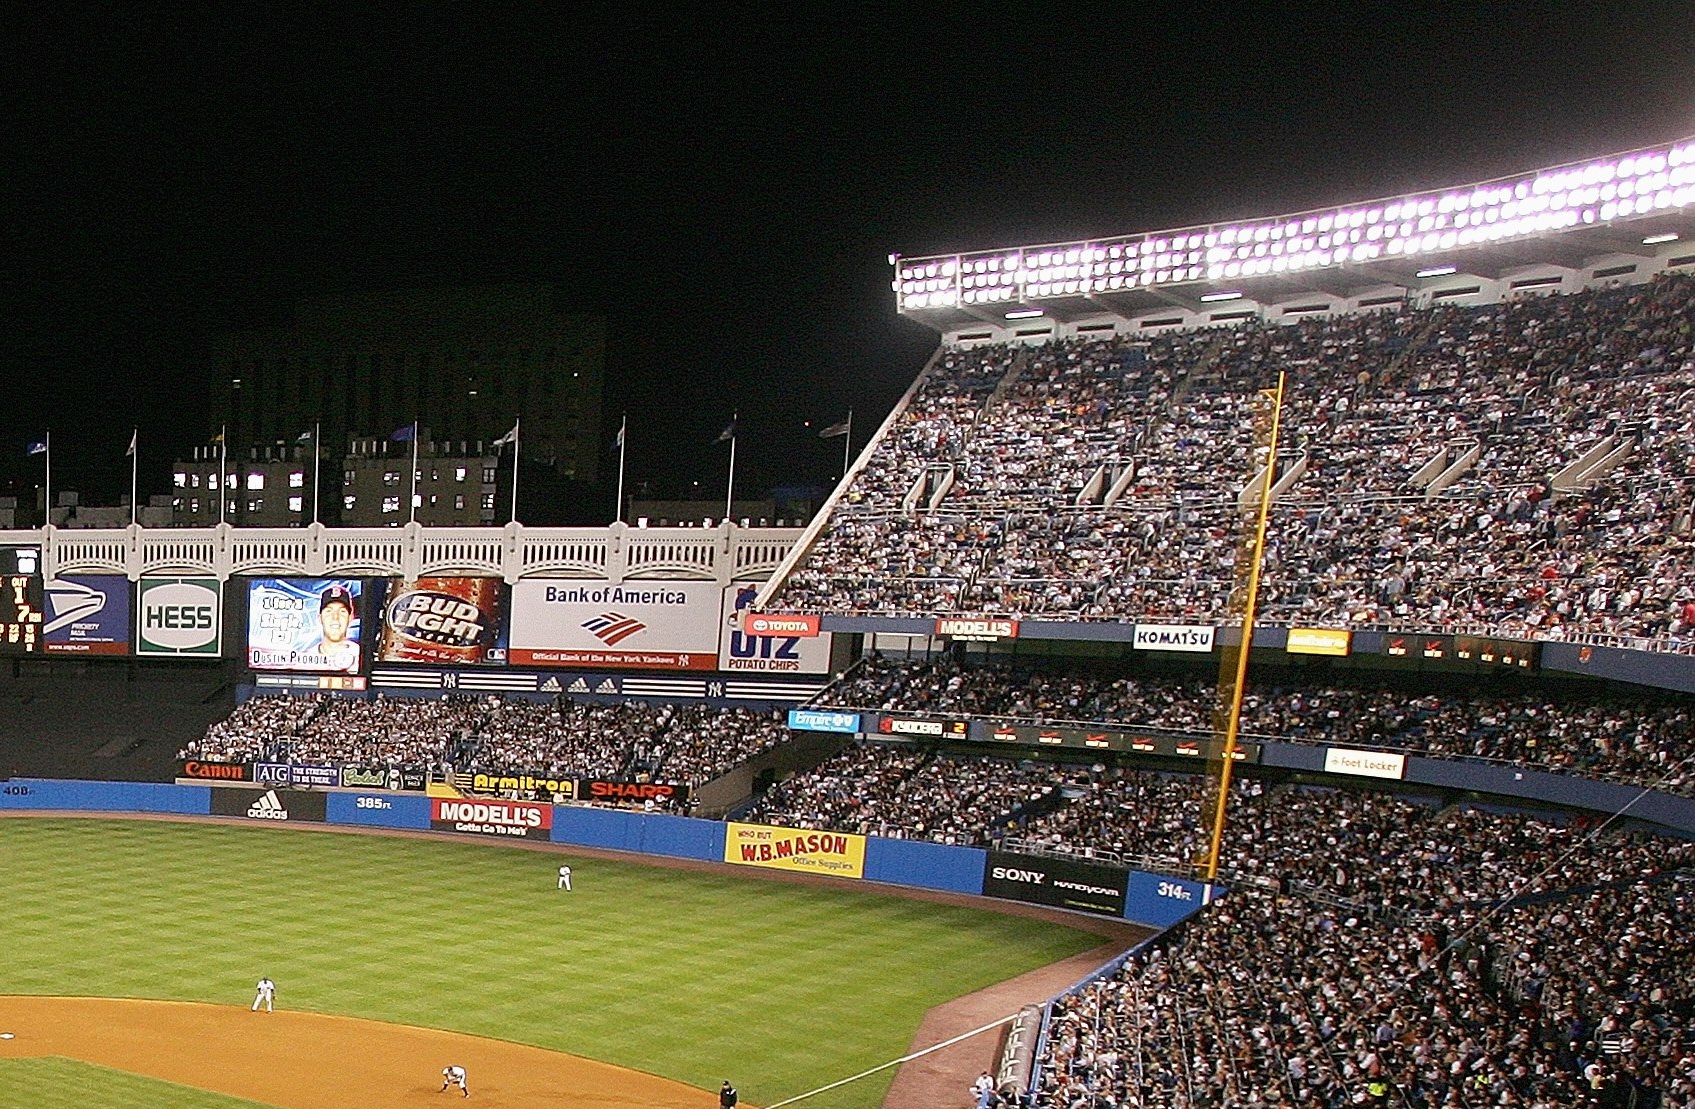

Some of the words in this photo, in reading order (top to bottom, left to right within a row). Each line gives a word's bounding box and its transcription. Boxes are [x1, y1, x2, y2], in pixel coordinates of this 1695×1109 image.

[11, 578, 27, 587] OUT
[14, 586, 24, 604] 1
[546, 586, 589, 603] Bank
[590, 586, 609, 603] of
[611, 588, 686, 604] America
[17, 604, 29, 622] 7
[407, 595, 479, 622] BUD
[147, 606, 211, 628] HESS
[393, 610, 484, 640] LIGHT
[767, 621, 808, 631] TOYOTA
[940, 620, 1012, 636] MODELL'S
[730, 631, 802, 659] UTZ
[1137, 628, 1209, 646] KOMATSU
[532, 653, 559, 661] Official
[560, 653, 579, 661] Bank
[591, 654, 603, 662] the
[624, 655, 641, 663] York
[642, 656, 674, 664] Yankees
[729, 659, 765, 670] POTATO
[769, 660, 799, 670] CHIPS
[892, 720, 943, 733] KYOCERA
[952, 722, 964, 733] 2
[185, 761, 245, 778] Canon
[259, 767, 287, 782] AIG
[473, 774, 573, 792] Armitron
[590, 782, 673, 798] SHARP
[247, 808, 287, 820] adidas
[440, 802, 542, 827] MODELL'S
[455, 823, 481, 832] Gotta
[482, 824, 495, 833] Go
[495, 825, 507, 834] To
[738, 830, 755, 838] WHO
[757, 832, 772, 840] BUT
[792, 857, 816, 866] Office
[817, 859, 853, 870] Supplies
[993, 868, 1045, 884] SONY
[1053, 880, 1119, 897] HANDYCAM
